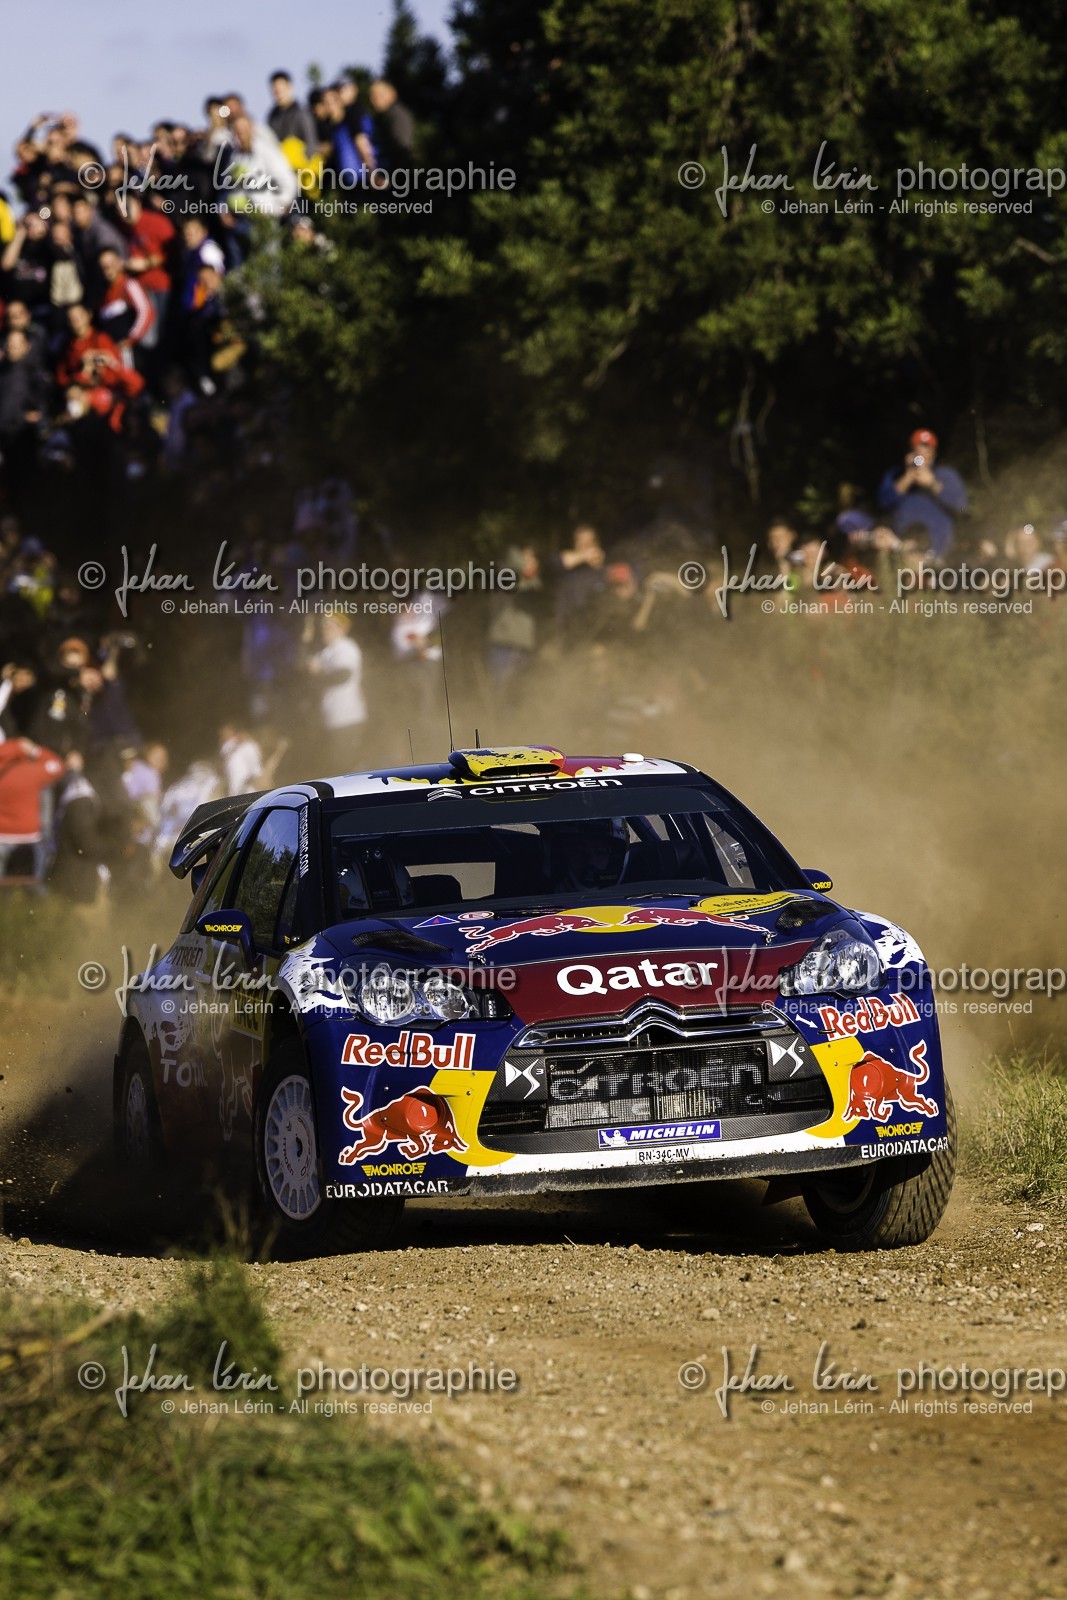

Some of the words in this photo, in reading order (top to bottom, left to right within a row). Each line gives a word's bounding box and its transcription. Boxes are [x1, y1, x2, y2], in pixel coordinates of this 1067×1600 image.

[812, 881, 831, 890] ONROE
[206, 924, 241, 932] MONROE
[556, 958, 718, 997] Qatar
[629, 1123, 716, 1141] MICHELIN
[878, 1122, 921, 1138] MONROE
[860, 1135, 949, 1160] EURODATACAR
[365, 1163, 422, 1176] MONROE
[326, 1180, 449, 1199] EURODATACAR
